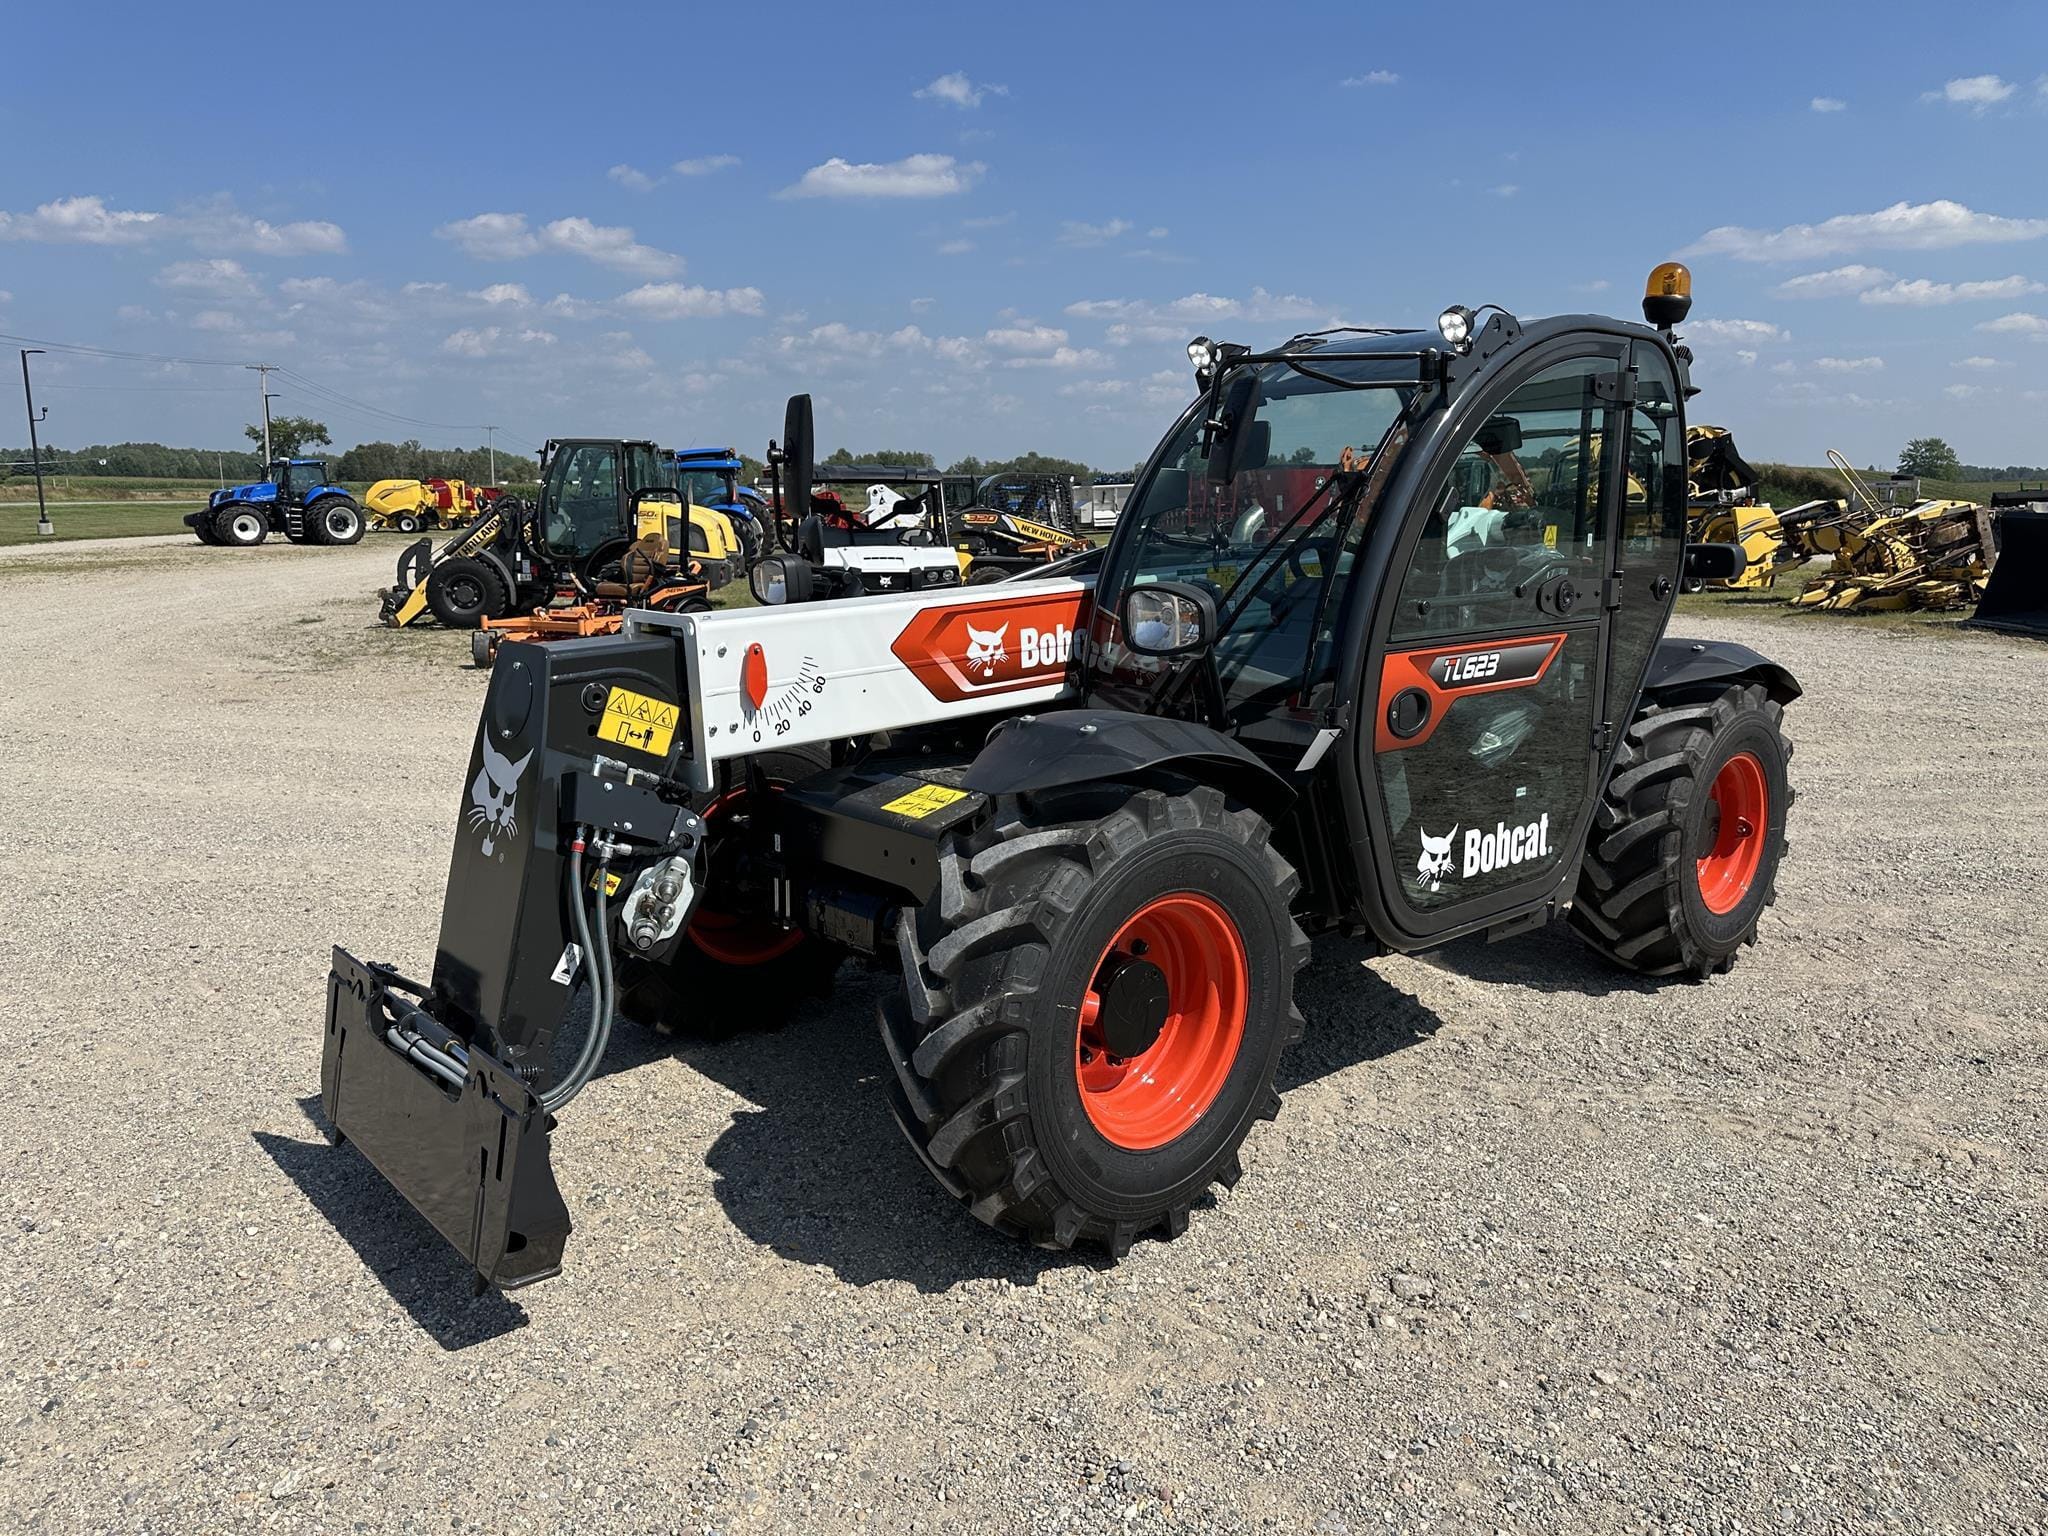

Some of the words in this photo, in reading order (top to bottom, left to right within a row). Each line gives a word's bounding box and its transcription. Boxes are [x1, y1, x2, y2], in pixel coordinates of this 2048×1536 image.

[1021, 524, 1041, 537] NEW
[1020, 624, 1087, 669] Bobc
[1444, 653, 1500, 682] TL623
[753, 730, 761, 743] 0
[775, 719, 790, 736] 20
[798, 700, 812, 717] 40
[813, 676, 826, 694] 60
[1463, 813, 1549, 879] Bobcat
